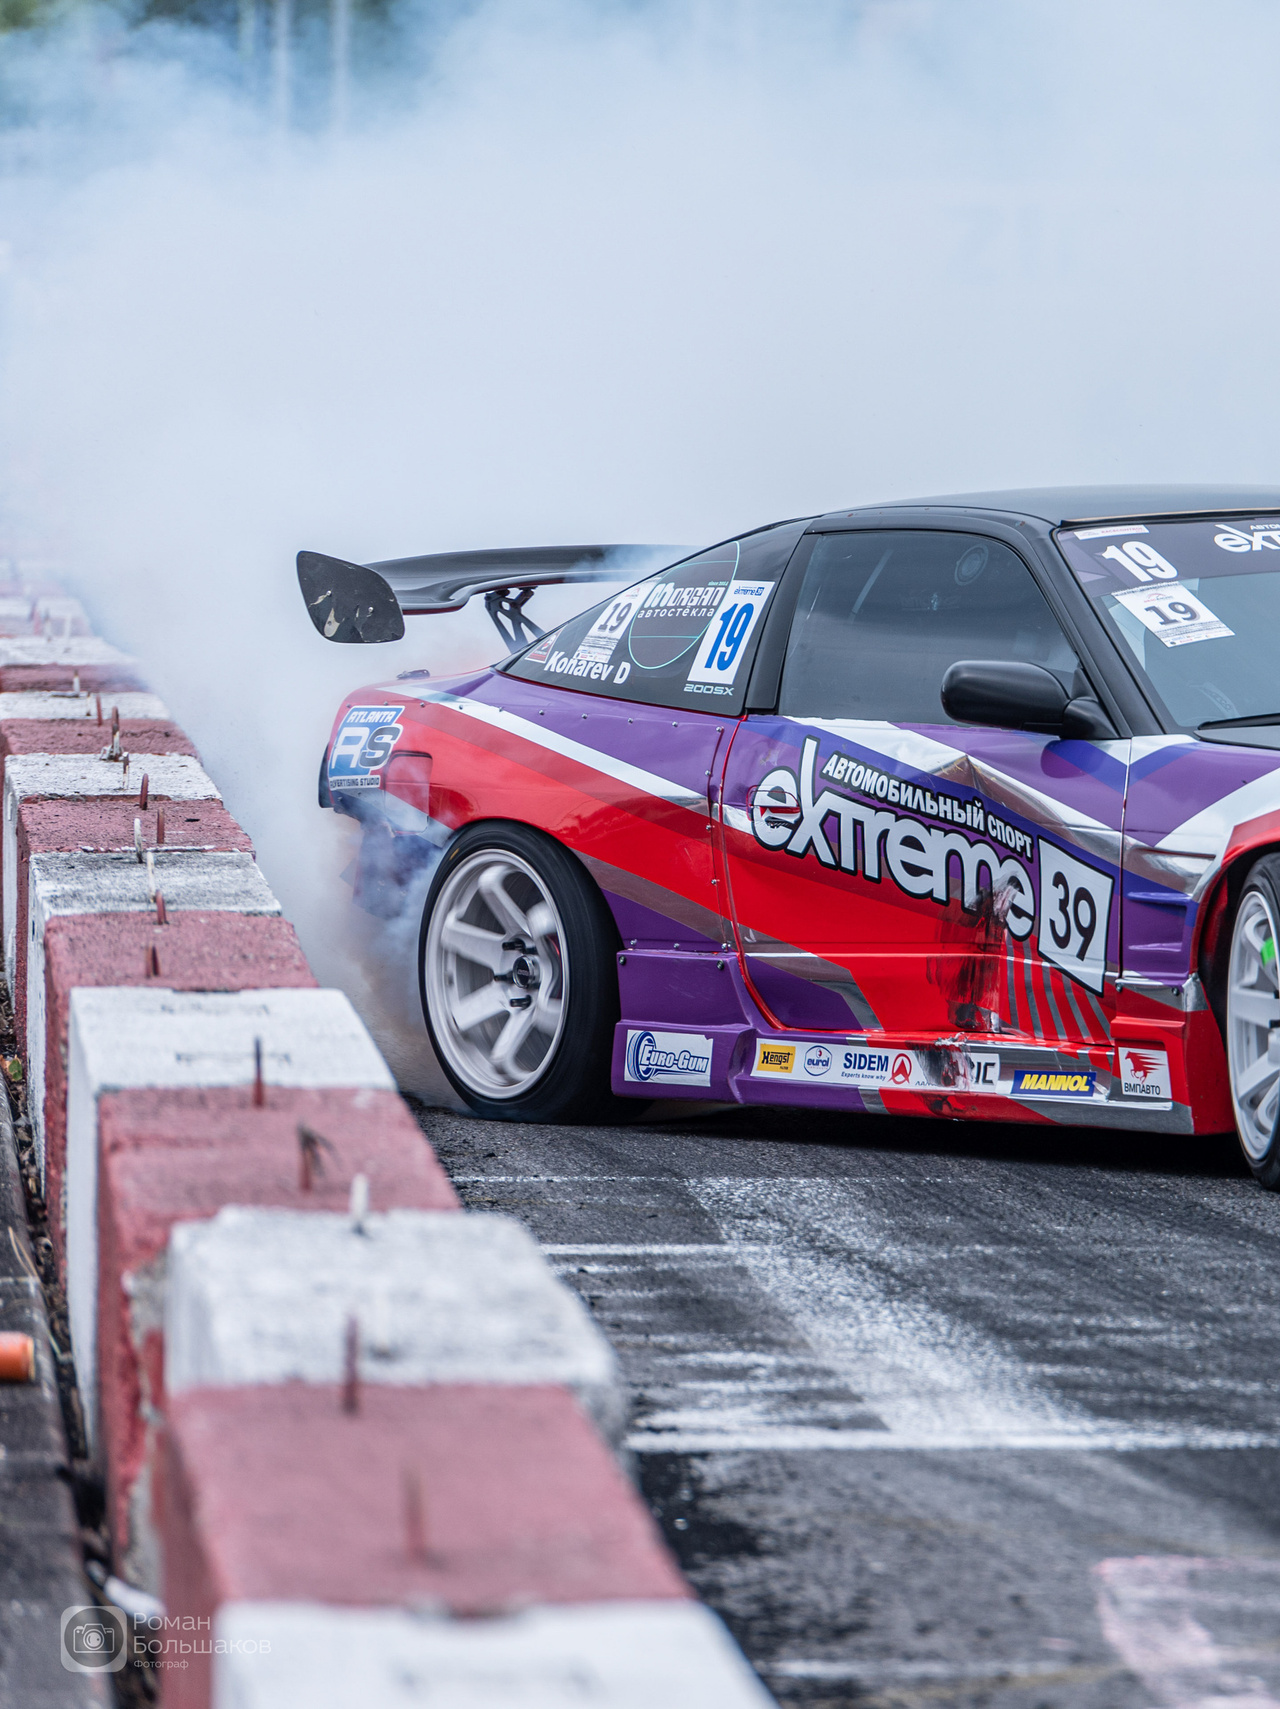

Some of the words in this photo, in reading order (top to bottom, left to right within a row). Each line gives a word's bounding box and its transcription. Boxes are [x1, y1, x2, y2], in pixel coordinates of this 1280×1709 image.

[1102, 541, 1178, 582] 19
[598, 602, 632, 633] 19
[637, 605, 715, 618] автостёкла
[1144, 602, 1199, 625] 19
[704, 602, 754, 671] 19
[544, 651, 614, 681] Konarev
[613, 661, 631, 684] D
[684, 684, 734, 696] 200SX
[346, 711, 397, 723] ATLANTA
[821, 751, 987, 835] АВТОМОБИЛЬНЫЙ
[986, 814, 1034, 861] СПОРТ
[1048, 870, 1098, 962] 39
[843, 1052, 889, 1072] SIDEM
[1020, 1074, 1090, 1092] MANNOL
[1124, 1082, 1161, 1096] ВМПАВТО
